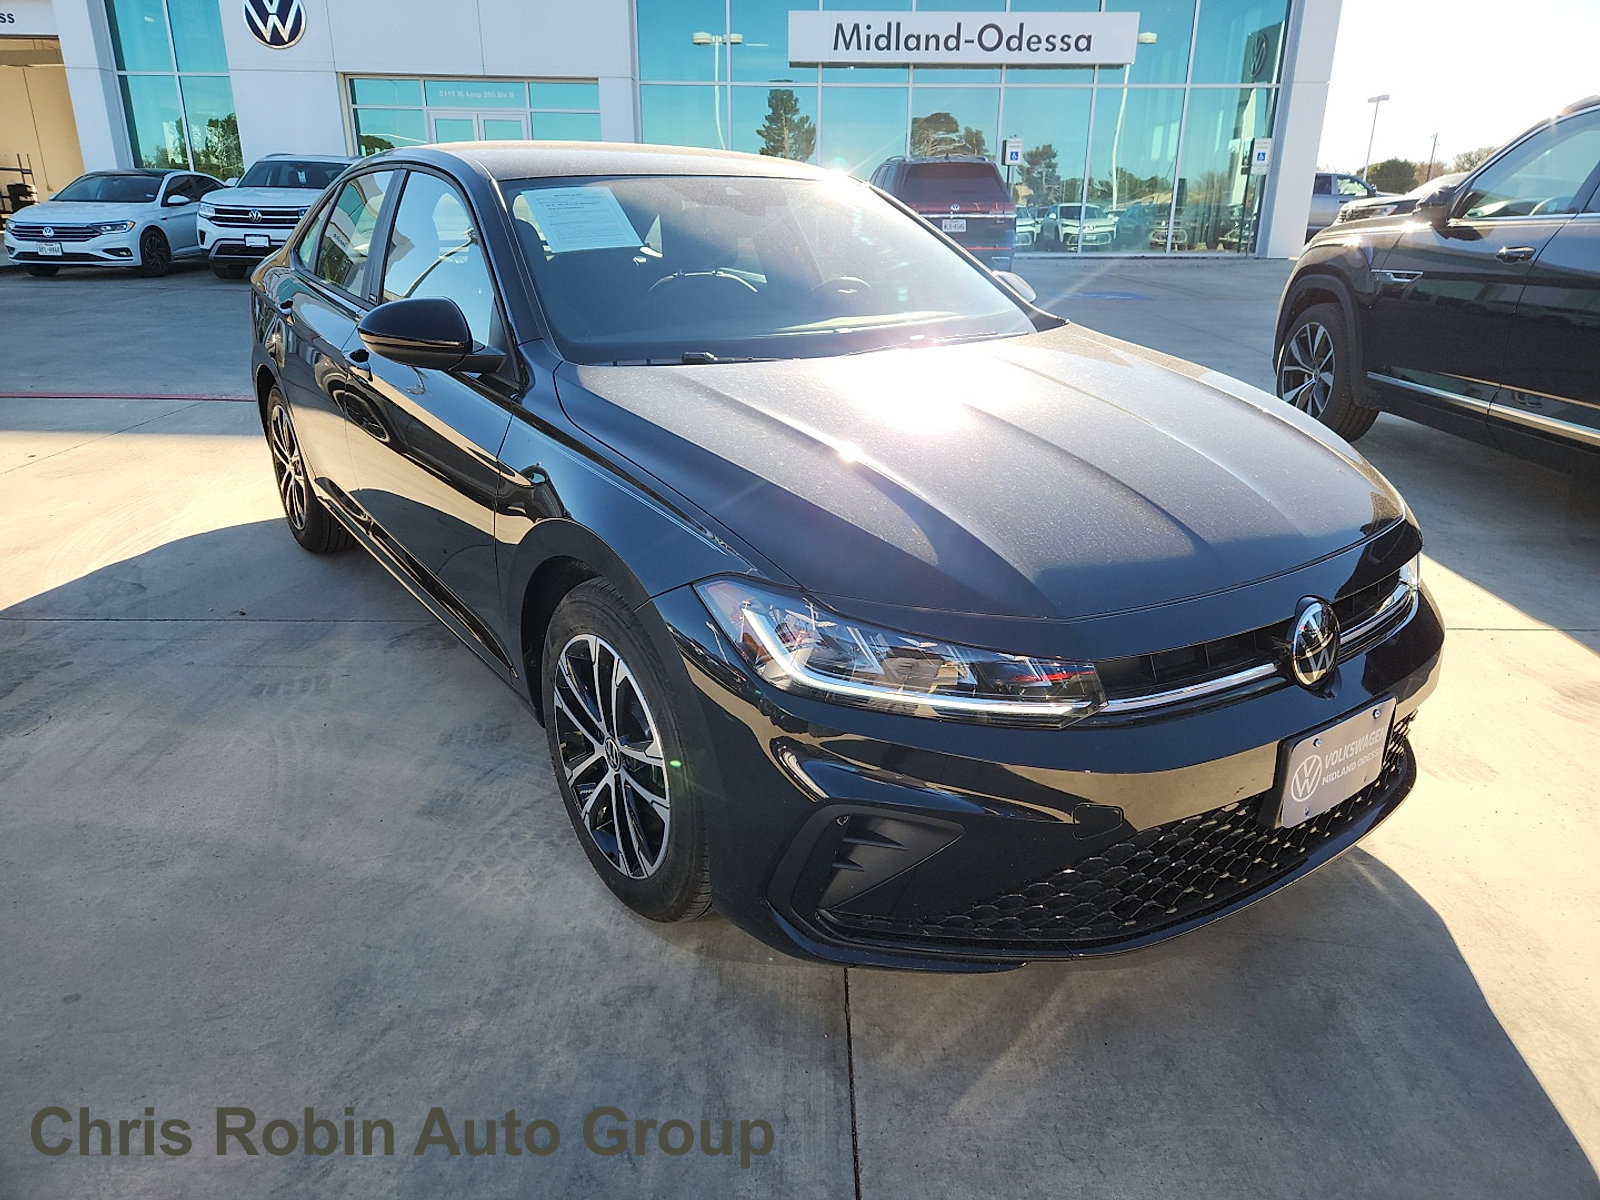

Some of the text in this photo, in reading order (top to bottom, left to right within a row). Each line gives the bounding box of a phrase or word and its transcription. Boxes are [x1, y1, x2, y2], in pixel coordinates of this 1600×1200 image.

[833, 22, 1093, 52] Midland-Odessa
[1325, 726, 1389, 769] VOLKSWAGEN
[1322, 762, 1356, 786] MIDLAND
